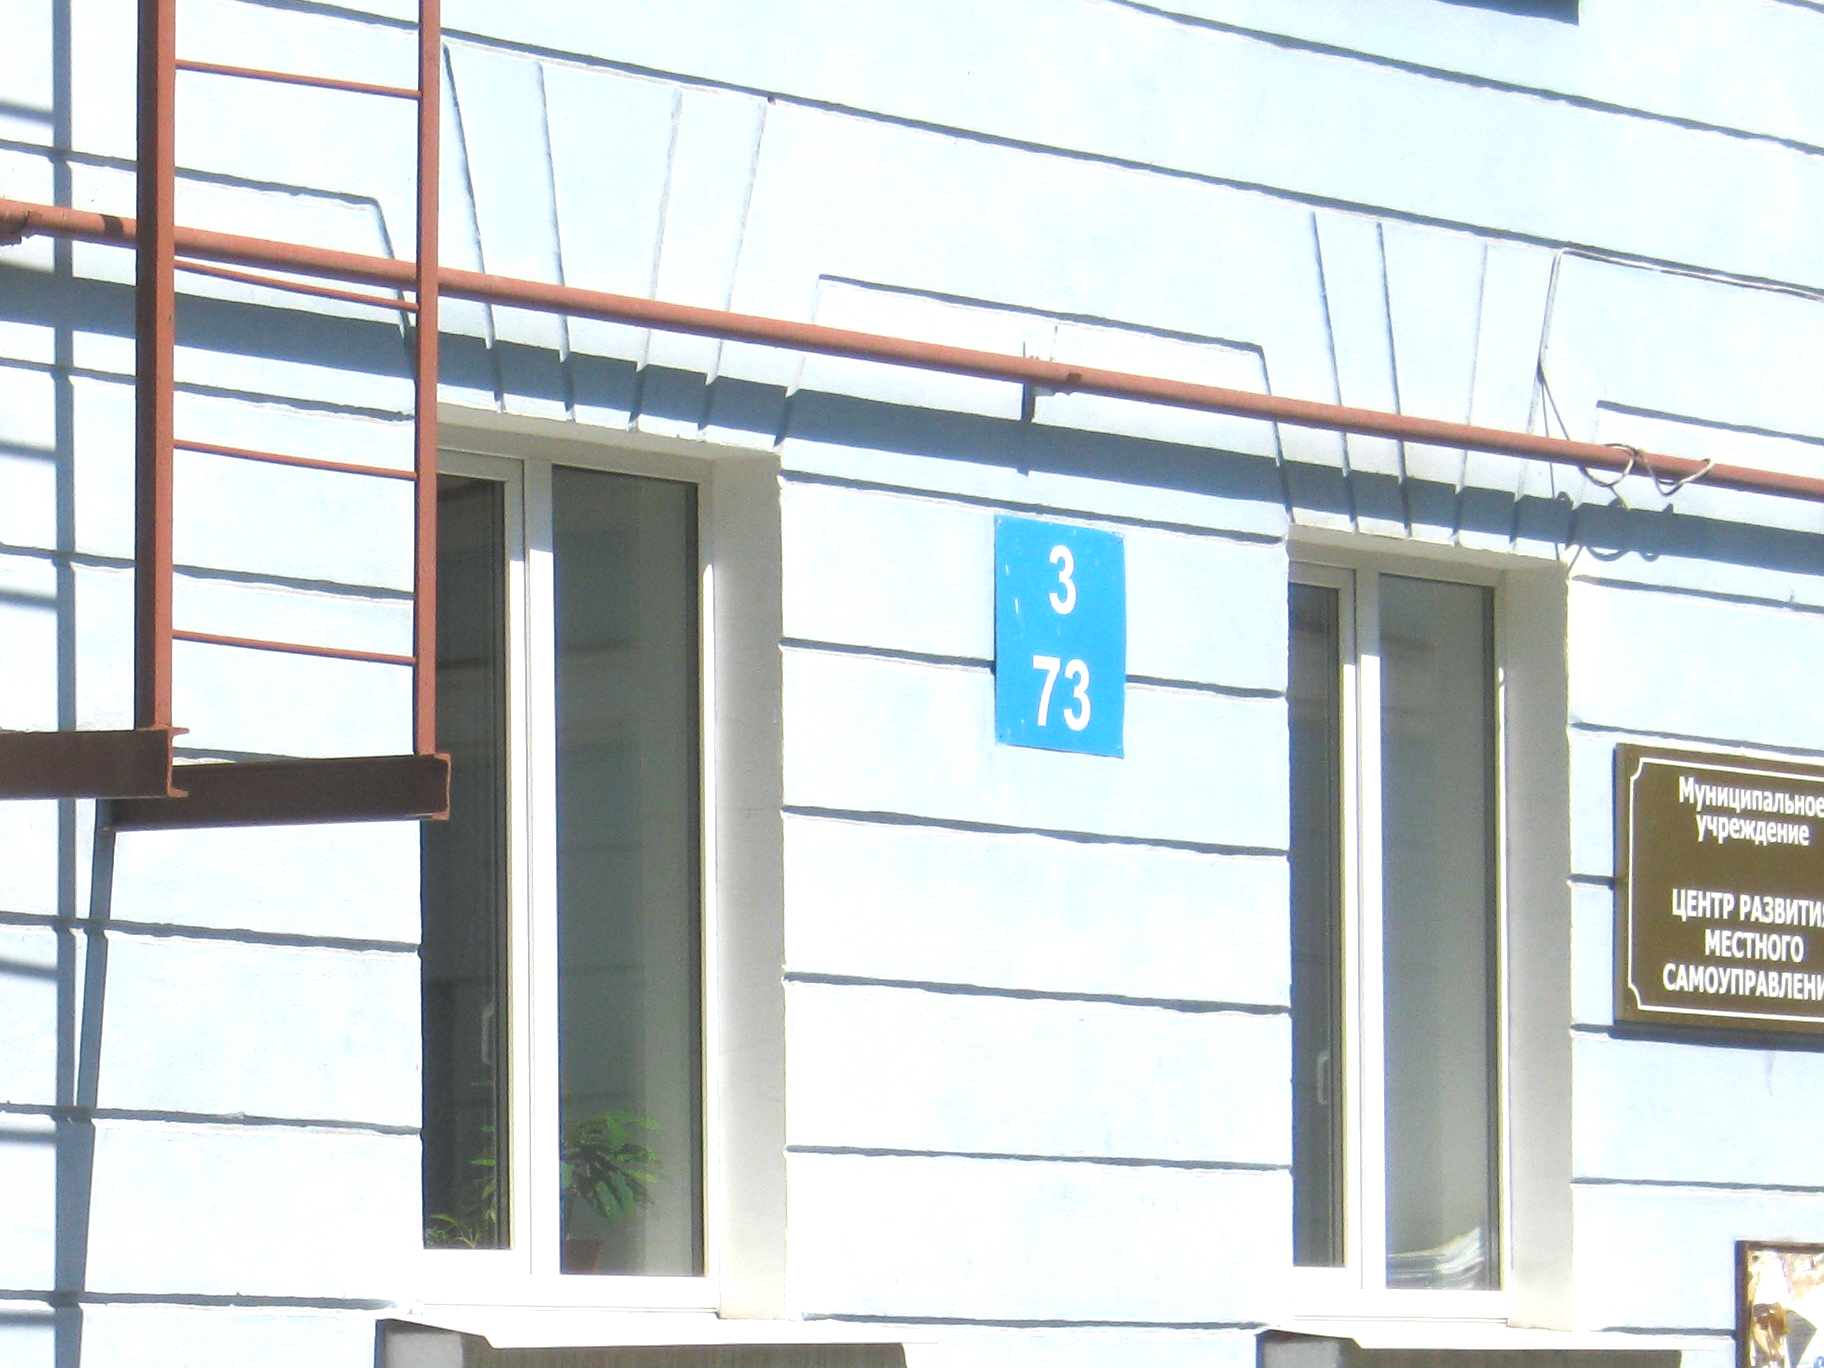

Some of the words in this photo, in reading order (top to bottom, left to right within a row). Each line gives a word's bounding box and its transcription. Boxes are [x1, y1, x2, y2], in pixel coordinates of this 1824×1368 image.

[1049, 544, 1077, 615] 3
[1032, 655, 1091, 731] 73
[1678, 775, 1824, 819] Муниципальное
[1695, 813, 1810, 846] учреждение
[1671, 888, 1735, 922] ЦЕНТР
[1704, 928, 1805, 963] МЕСТНОГО
